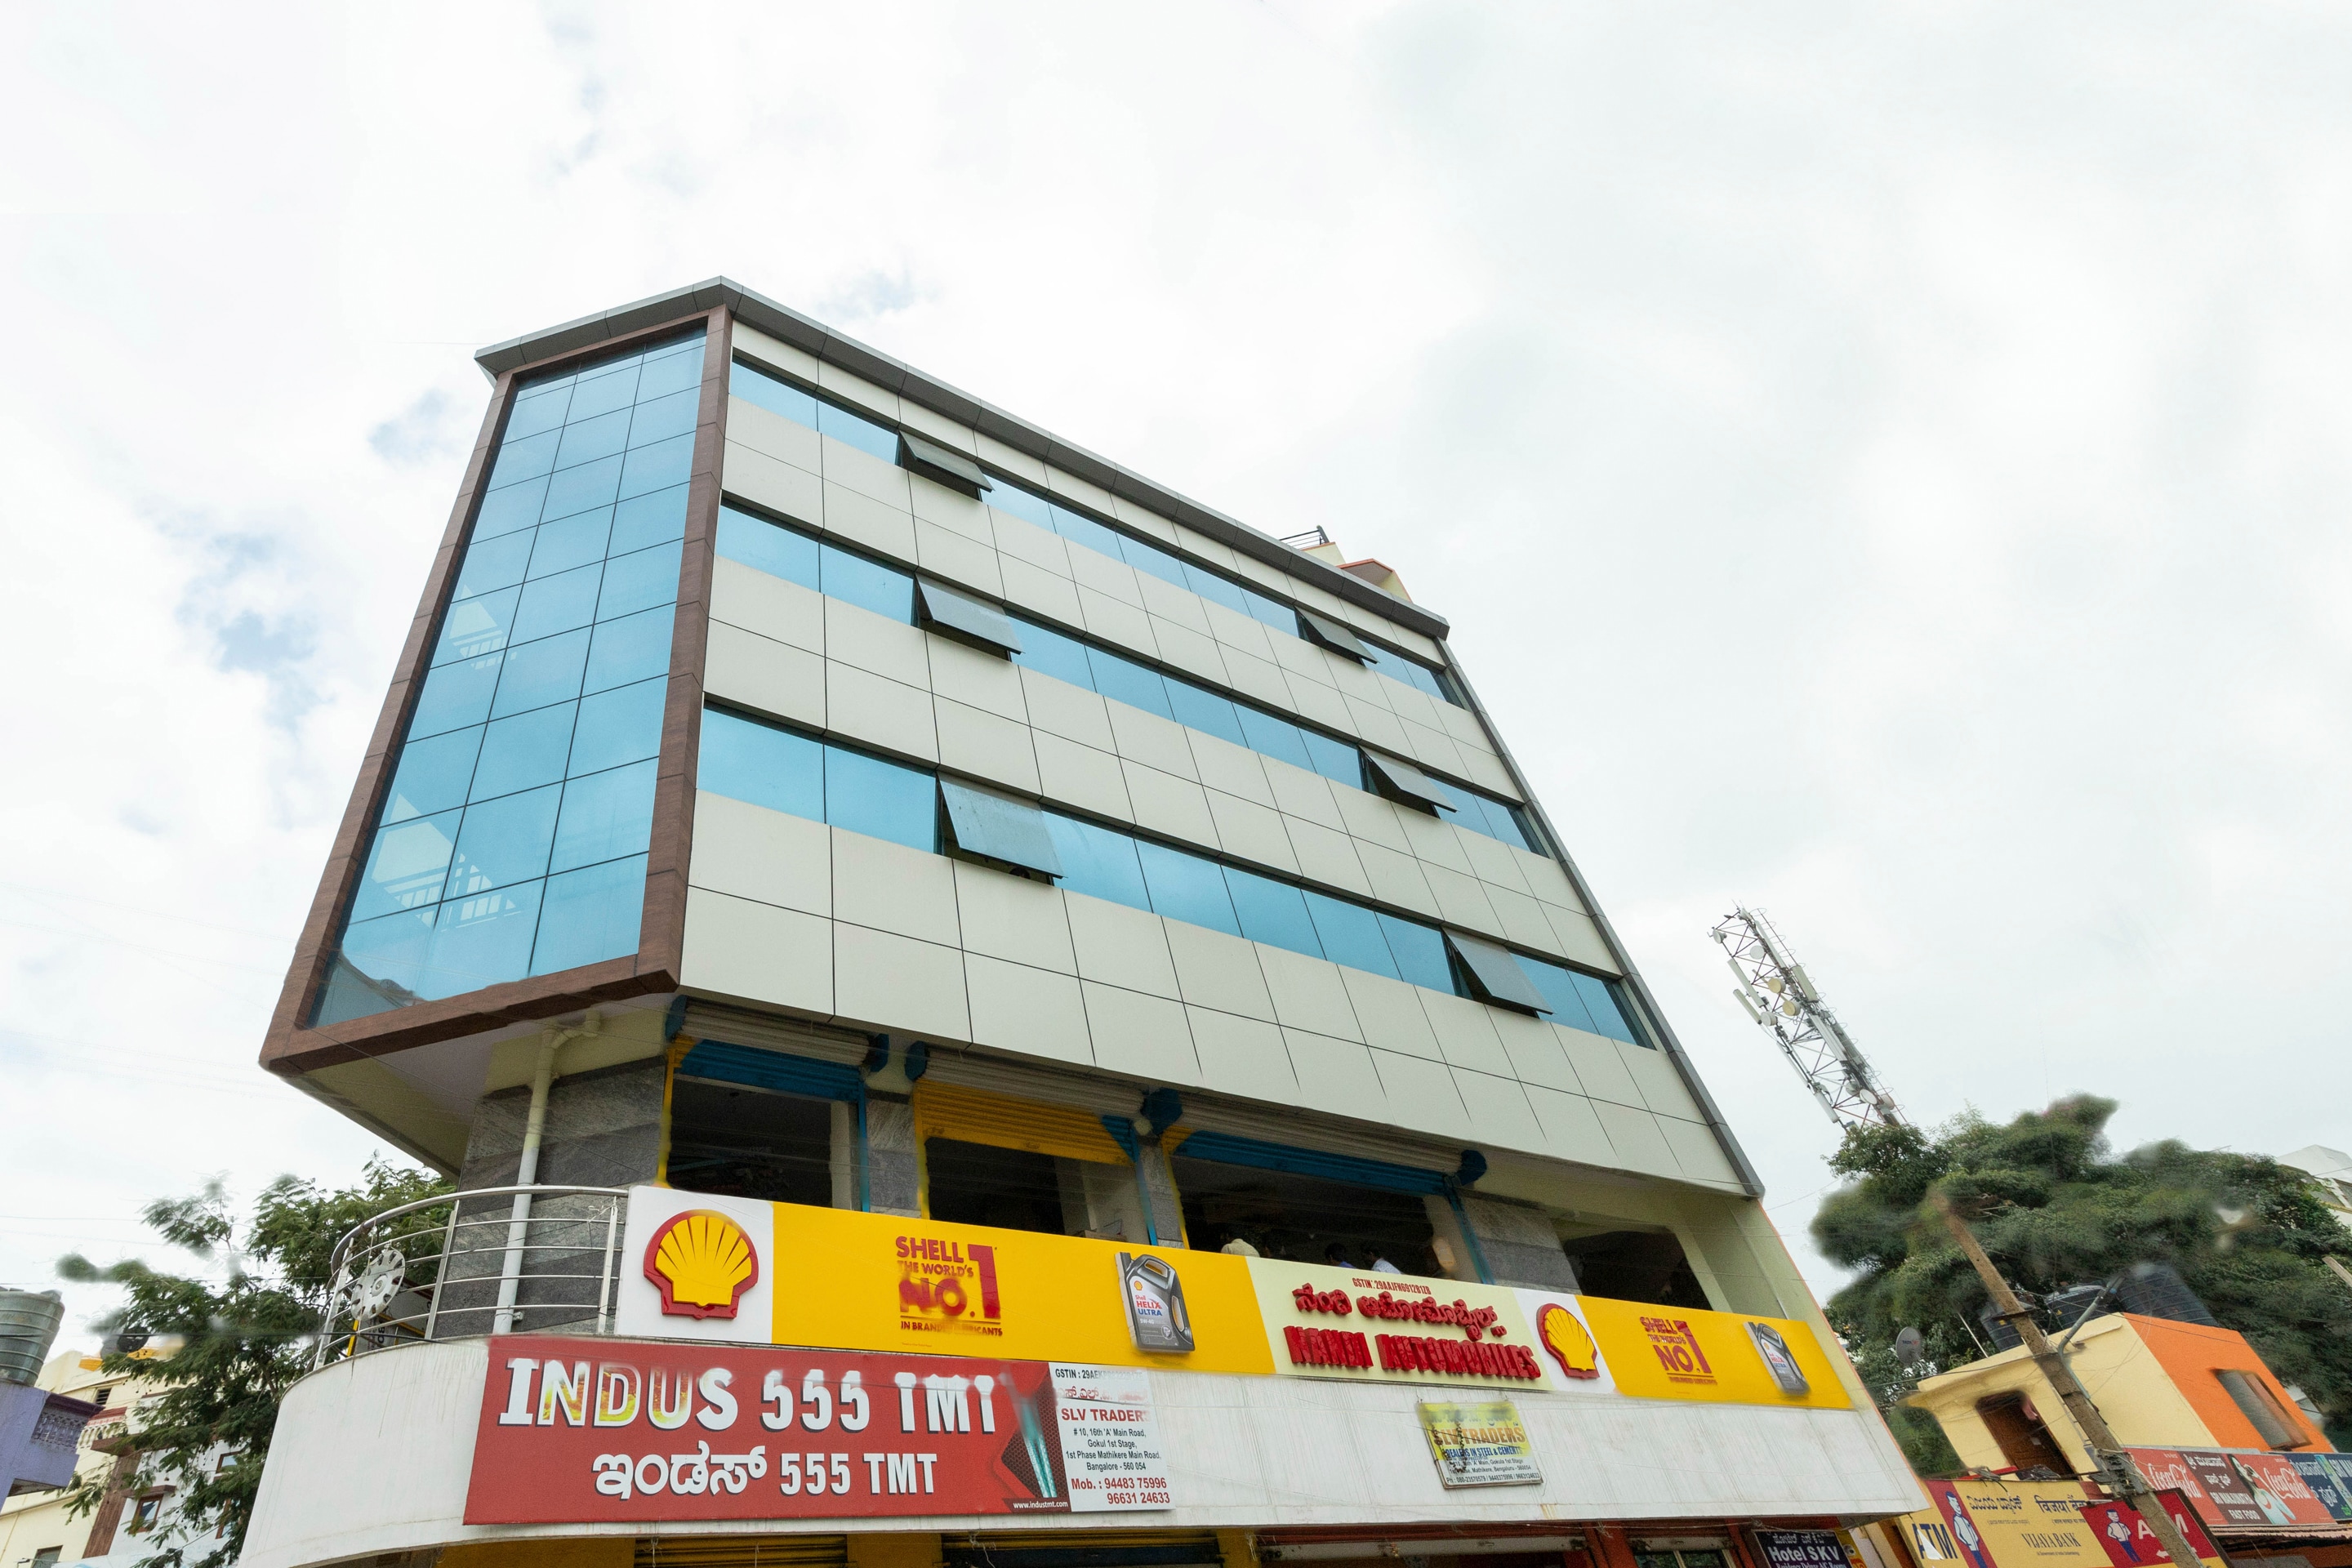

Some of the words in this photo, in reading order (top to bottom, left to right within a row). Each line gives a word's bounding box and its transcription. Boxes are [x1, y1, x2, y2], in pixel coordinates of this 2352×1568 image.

[895, 1236, 964, 1263] SHELL
[897, 1260, 920, 1273] THE
[920, 1263, 974, 1277] WORLD'S
[1136, 1300, 1163, 1309] HELIX
[1138, 1308, 1163, 1316] ULTRA
[900, 1321, 911, 1330] IN
[1639, 1316, 1678, 1334] SHELL
[1283, 1325, 1374, 1370] NANDI
[1374, 1334, 1542, 1380] AUTOMOBILES
[1055, 1368, 1077, 1379] GSTIN
[498, 1357, 738, 1431] INDUS
[761, 1369, 870, 1431] 555
[894, 1372, 996, 1432] TMT
[1062, 1408, 1086, 1421] SLV
[1079, 1428, 1089, 1437] 10,
[1089, 1428, 1103, 1437] 16th
[1113, 1428, 1127, 1437] Main
[1129, 1428, 1147, 1438] Road,
[1432, 1428, 1459, 1446] LV
[1461, 1427, 1526, 1446] TRADERS
[1087, 1439, 1107, 1448] Gokul
[1107, 1440, 1117, 1448] 1st
[1117, 1440, 1138, 1450] Stage,
[1066, 1450, 1076, 1459] 1st
[1076, 1450, 1095, 1459] Phase
[1097, 1450, 1127, 1459] Mathikere
[1128, 1450, 1143, 1459] Main
[1143, 1450, 1161, 1460] Road,
[1446, 1448, 1470, 1458] DEALES
[1469, 1447, 1477, 1456] IN
[1477, 1446, 1494, 1457] STEEL
[593, 1440, 768, 1500] ಇಂಡಸ್
[780, 1453, 851, 1495] 555
[862, 1453, 938, 1494] TMT
[1086, 1462, 1119, 1472] Bangalore
[1123, 1462, 1134, 1470] 560
[1134, 1462, 1147, 1470] 054
[1071, 1477, 1096, 1490] Mob.
[1104, 1477, 1135, 1490] 94483
[1136, 1477, 1167, 1489] 75996
[1107, 1492, 1138, 1504] 96631
[1139, 1491, 1170, 1504] 24633
[2034, 1494, 2072, 1513] विजया
[1013, 1500, 1068, 1509] www.industmt.com
[2241, 1509, 2261, 1520] FOOD
[2137, 1513, 2189, 1540] AM
[2021, 1533, 2057, 1548] VIJAYA
[2052, 1532, 2082, 1548] BANK
[1767, 1546, 1807, 1561] Hotel
